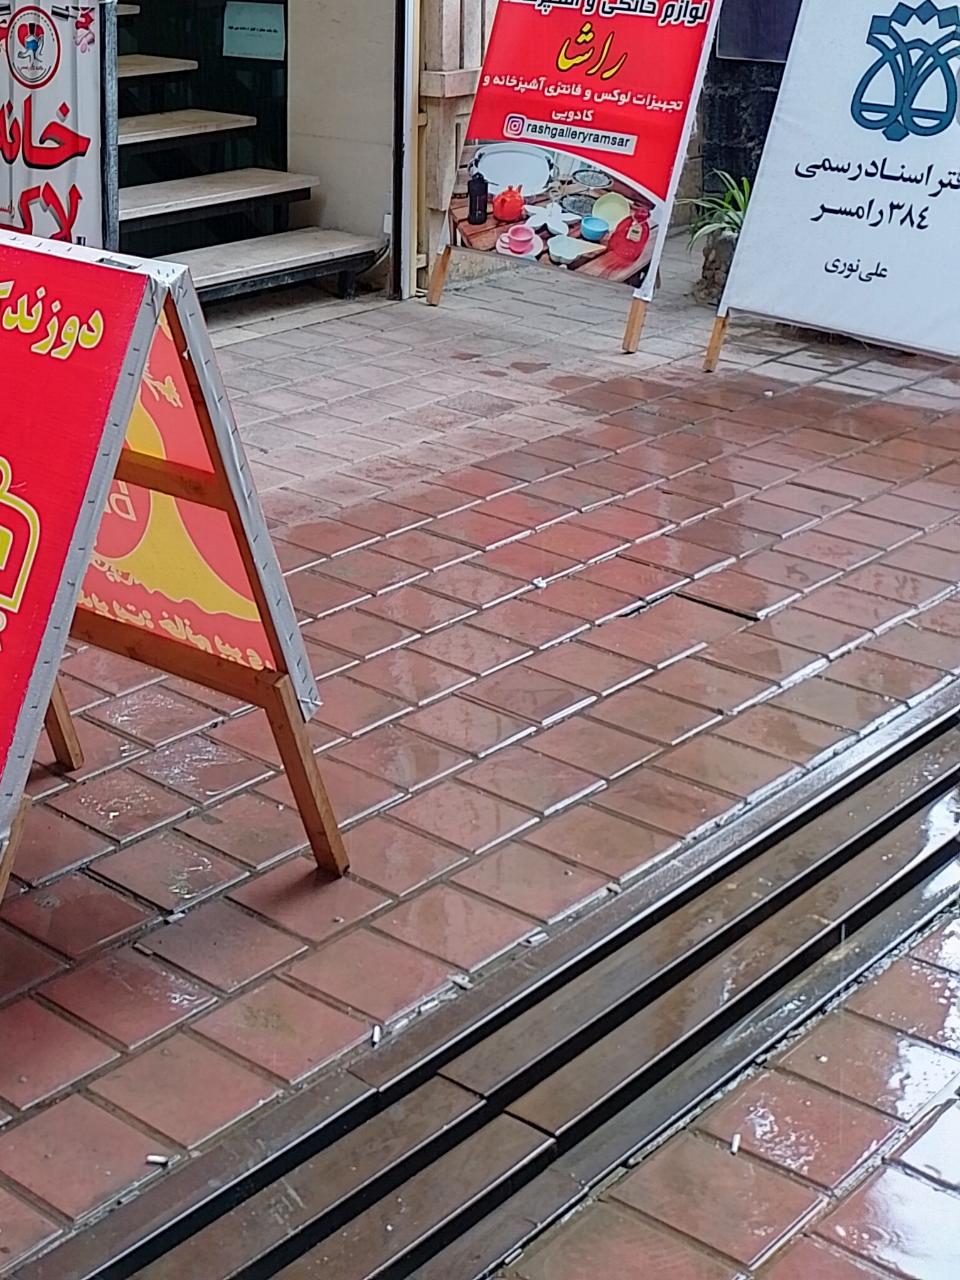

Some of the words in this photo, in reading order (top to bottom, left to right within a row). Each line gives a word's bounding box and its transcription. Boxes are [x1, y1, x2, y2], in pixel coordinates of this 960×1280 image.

[556, 21, 628, 80] راشا
[493, 75, 546, 94] آشپزخانه
[544, 81, 582, 97] فانتزی
[583, 90, 591, 100] و
[593, 90, 631, 105] لوکس
[632, 93, 684, 111] تجهیزات
[552, 109, 594, 121] کادویی
[526, 121, 630, 148] rashgalleryramsar
[794, 158, 863, 181] رسمی
[864, 157, 934, 186] اسناد
[810, 198, 884, 227] رامسر
[824, 257, 861, 279] نوری
[858, 261, 889, 282] علی
